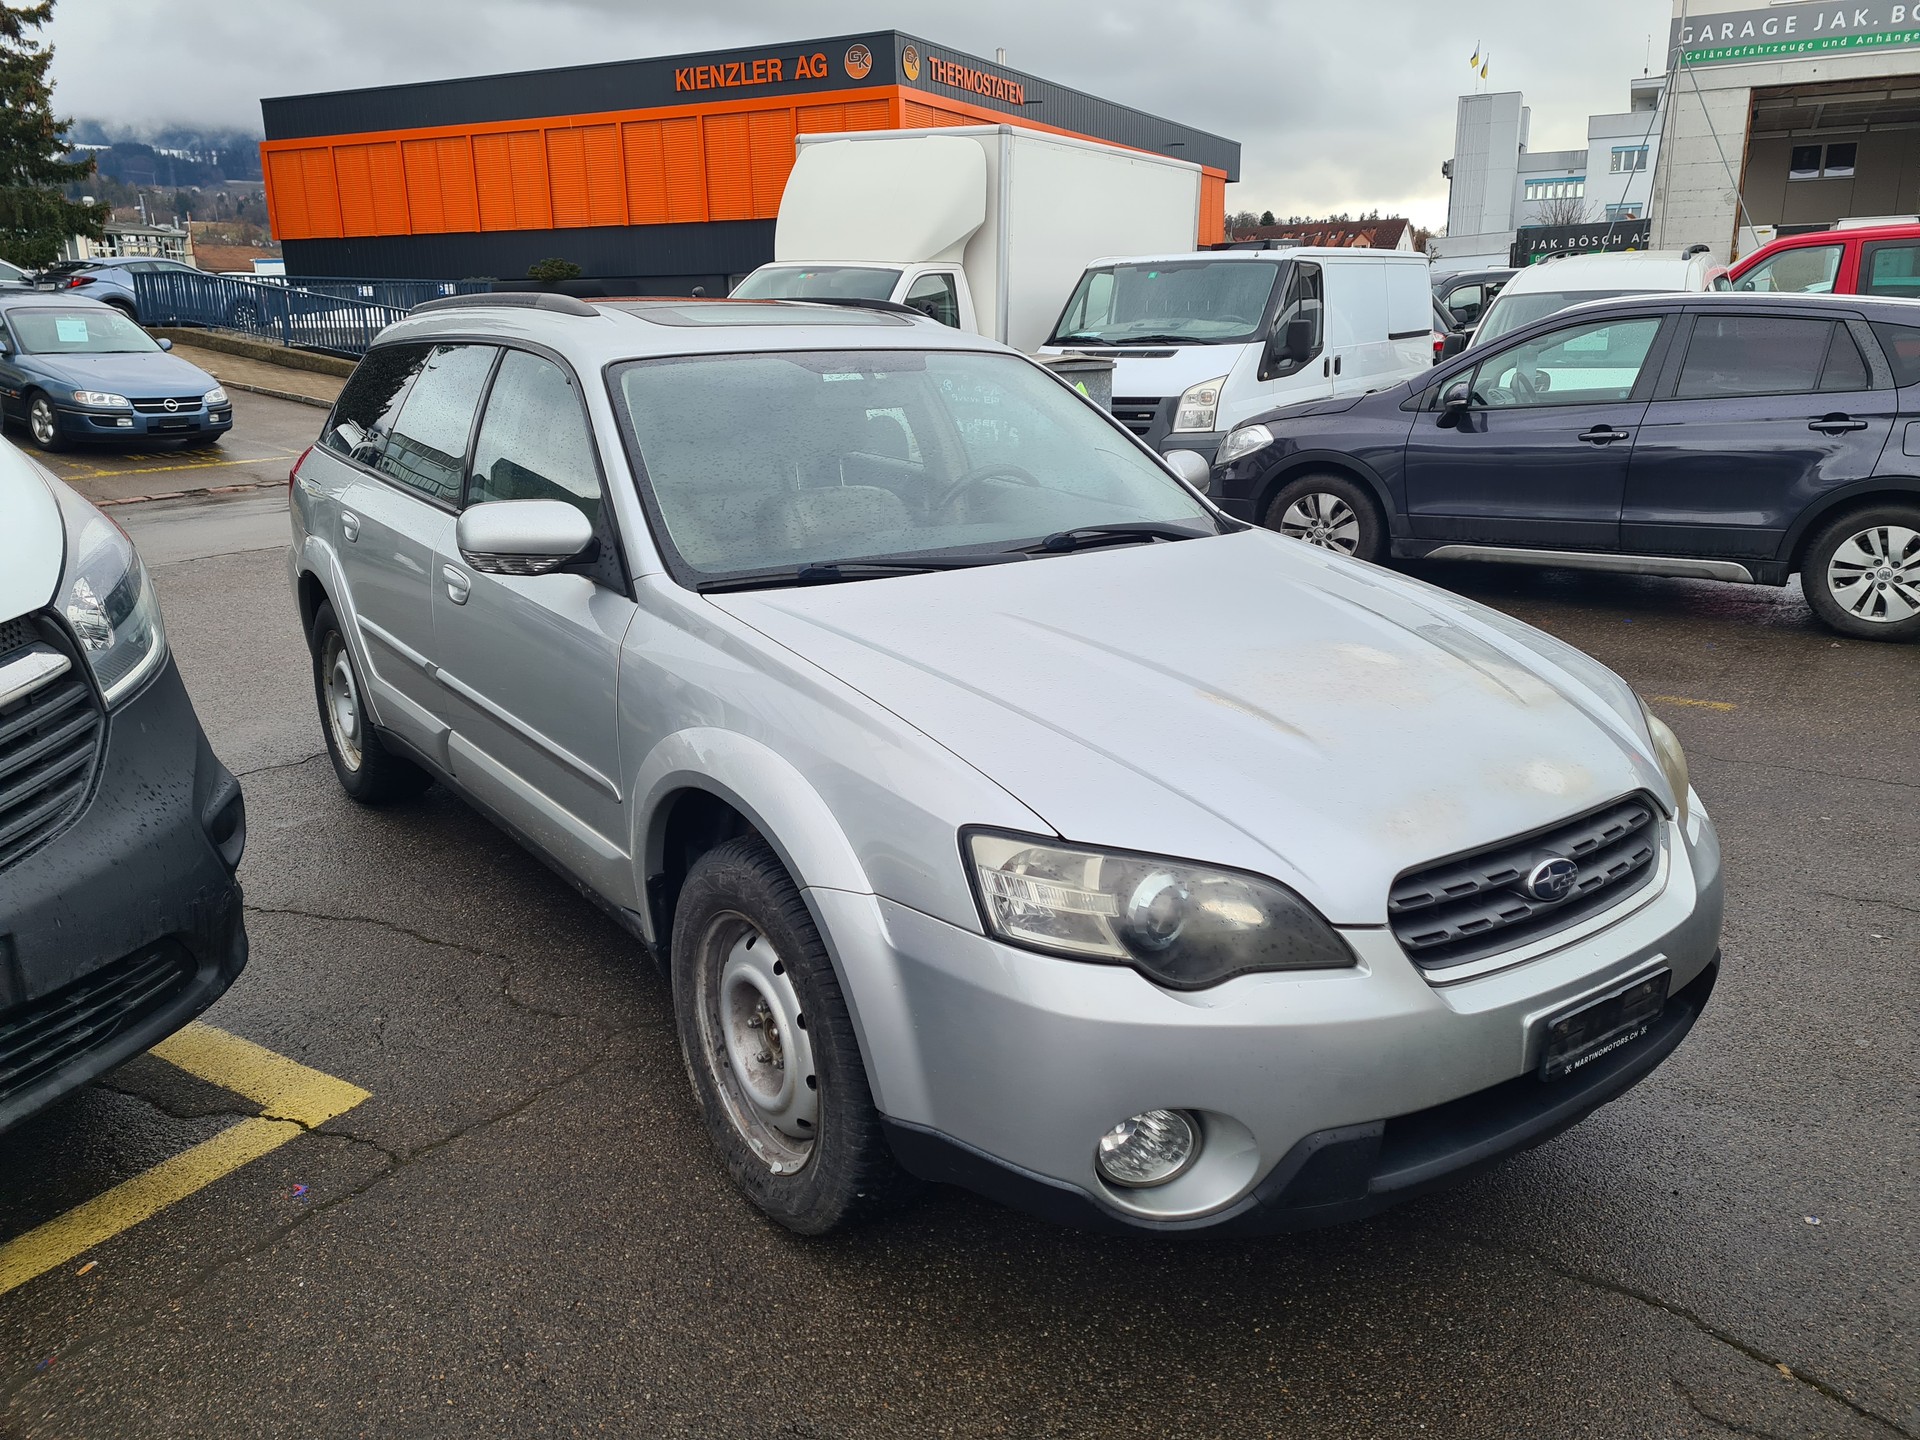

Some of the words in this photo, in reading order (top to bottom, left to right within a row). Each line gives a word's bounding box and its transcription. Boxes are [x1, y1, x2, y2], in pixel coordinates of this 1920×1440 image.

[1679, 16, 1797, 43] GARAGE
[1813, 8, 1878, 31] JAK.
[1685, 41, 1813, 60] Geländefahrzeuge
[1822, 37, 1847, 48] und
[1856, 32, 1920, 45] Anhänge
[675, 58, 783, 92] KIENZLER
[794, 53, 828, 80] AG
[928, 56, 1024, 105] THERMOSTATEN
[1530, 239, 1563, 250] JAK.
[1568, 234, 1622, 248] BÖSCH
[1631, 232, 1650, 243] AG
